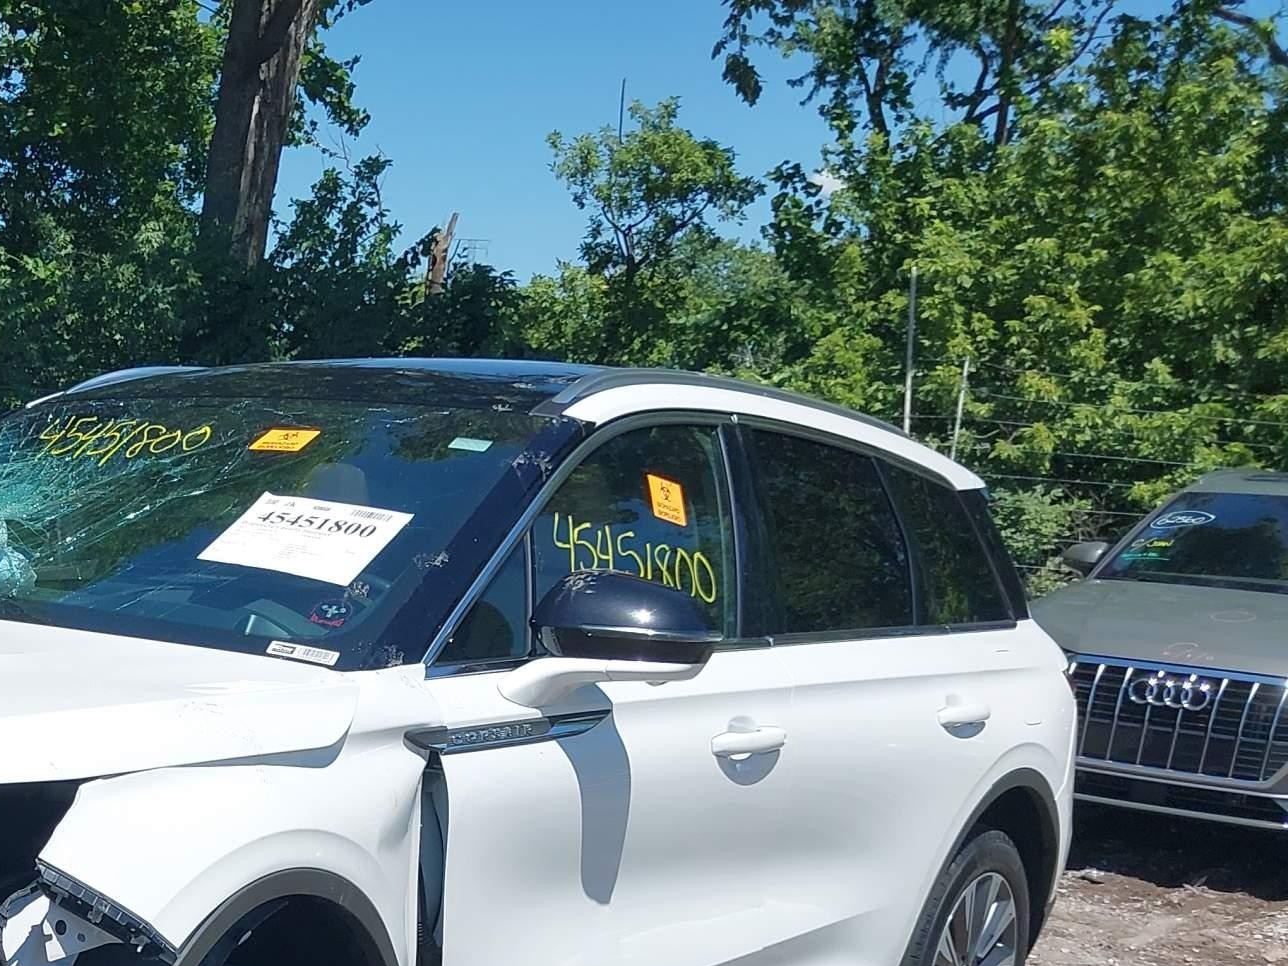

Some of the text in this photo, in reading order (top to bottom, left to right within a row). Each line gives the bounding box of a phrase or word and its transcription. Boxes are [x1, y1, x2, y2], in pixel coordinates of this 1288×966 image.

[35, 416, 211, 466] 45451800
[257, 511, 377, 538] 45451800
[553, 511, 716, 603] 45451800
[451, 723, 532, 746] CORSAIR
